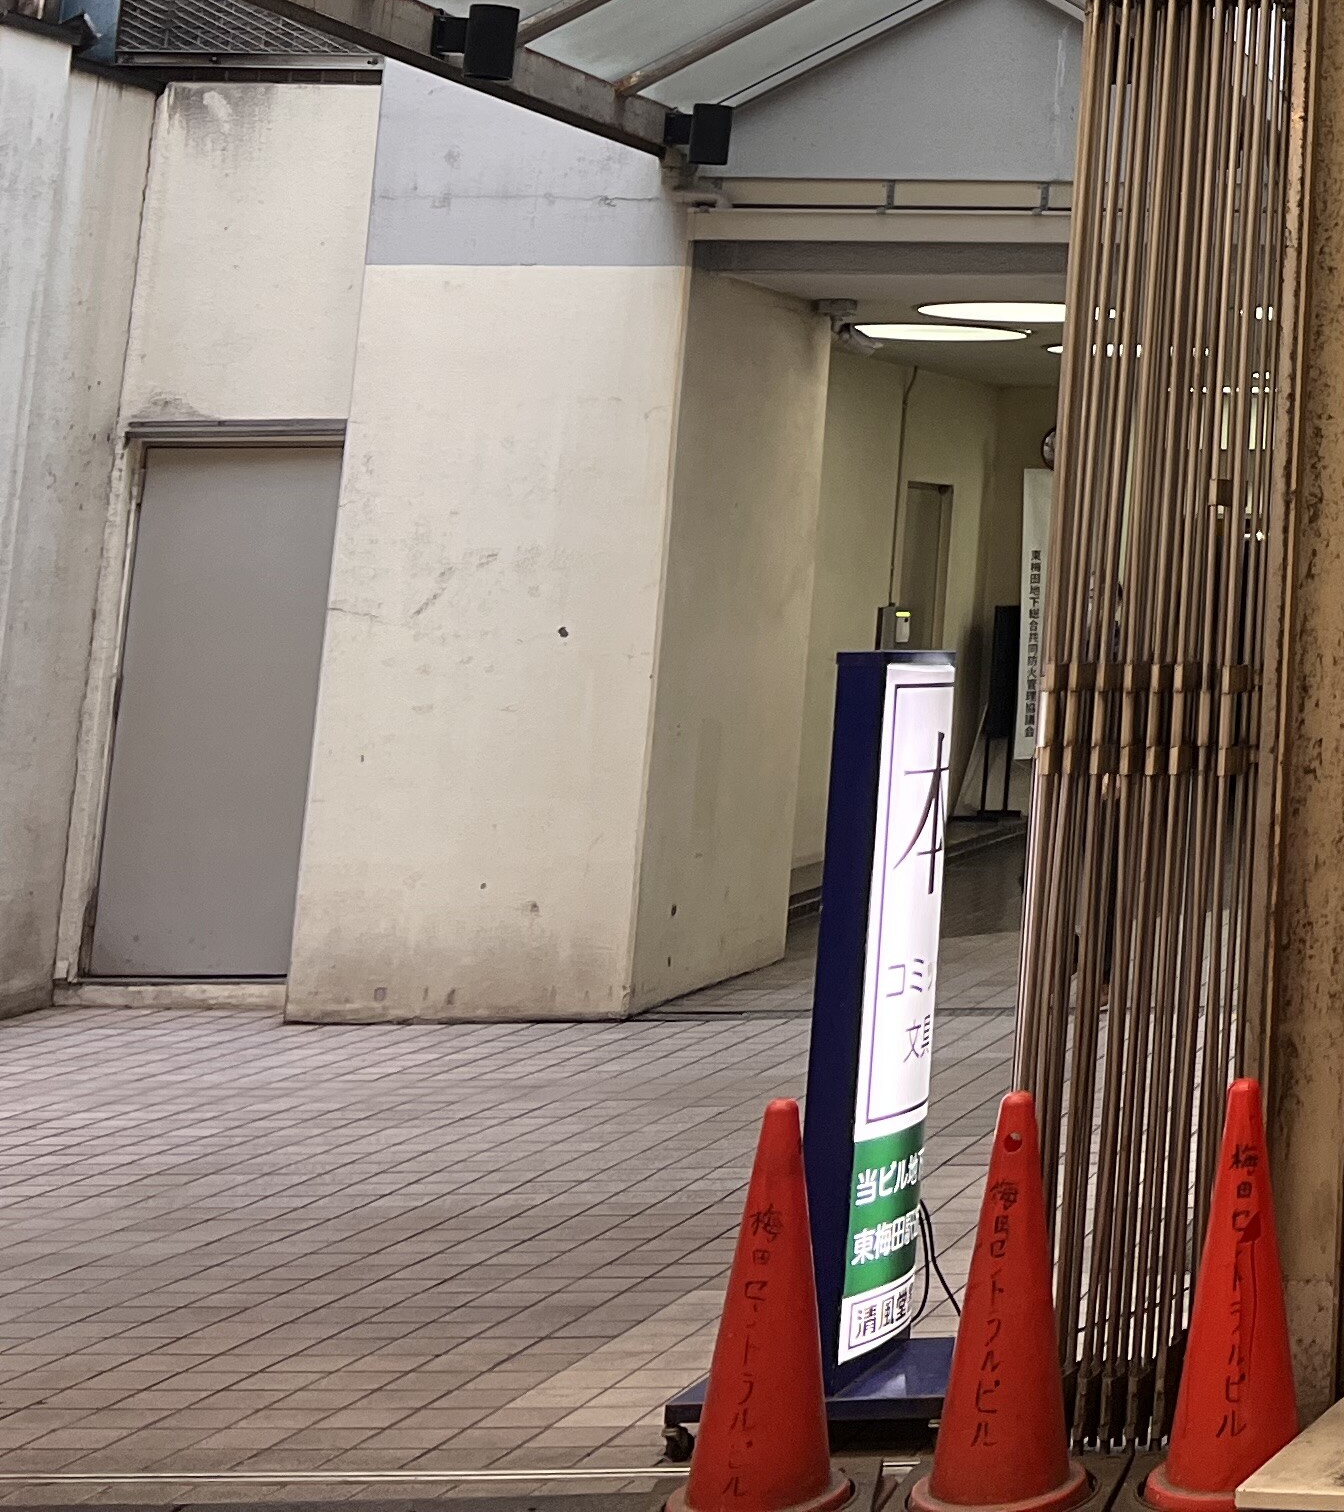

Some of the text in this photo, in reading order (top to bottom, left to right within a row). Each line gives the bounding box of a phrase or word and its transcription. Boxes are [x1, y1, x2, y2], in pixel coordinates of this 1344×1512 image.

[886, 958, 933, 998] コミ
[856, 1283, 912, 1339] 清風堂
